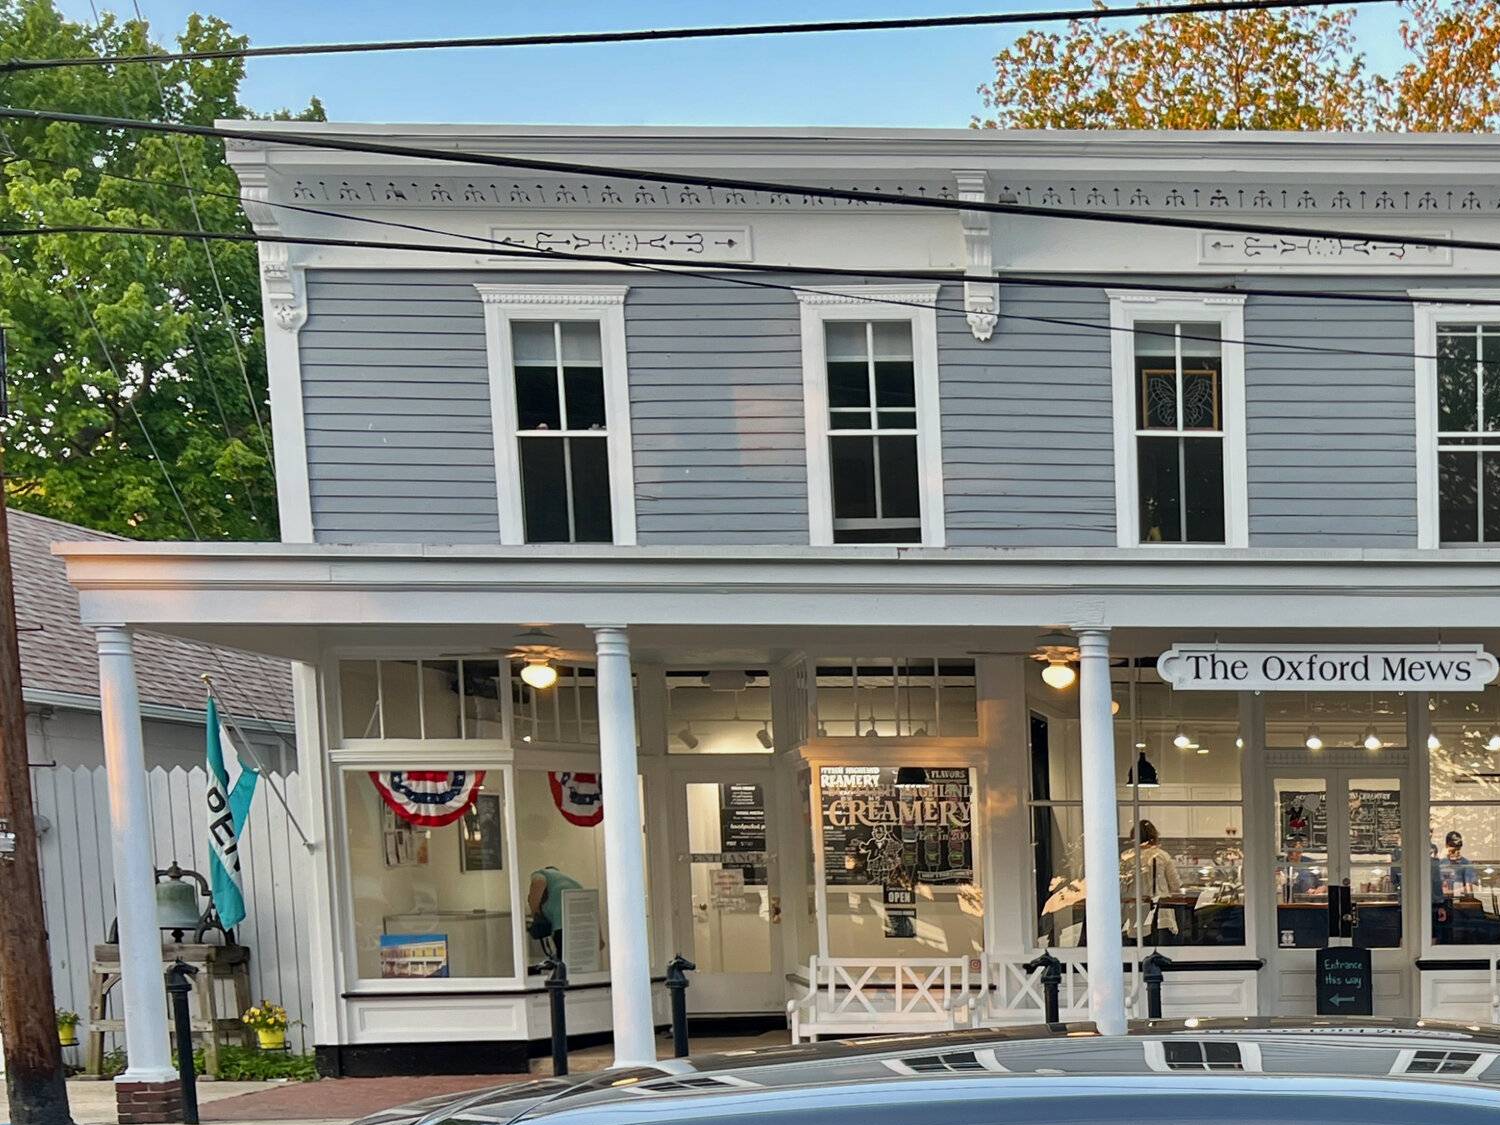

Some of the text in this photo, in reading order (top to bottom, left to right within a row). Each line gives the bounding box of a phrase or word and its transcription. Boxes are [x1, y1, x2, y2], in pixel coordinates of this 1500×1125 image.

[1186, 653, 1472, 682] The Oxford Mews
[821, 774, 880, 788] REAMERY
[828, 800, 971, 827] CREAMERY
[692, 853, 764, 863] ENTRANCE
[888, 891, 911, 903] OPEN
[1324, 959, 1363, 970] Entrance
[1345, 977, 1362, 989] way
